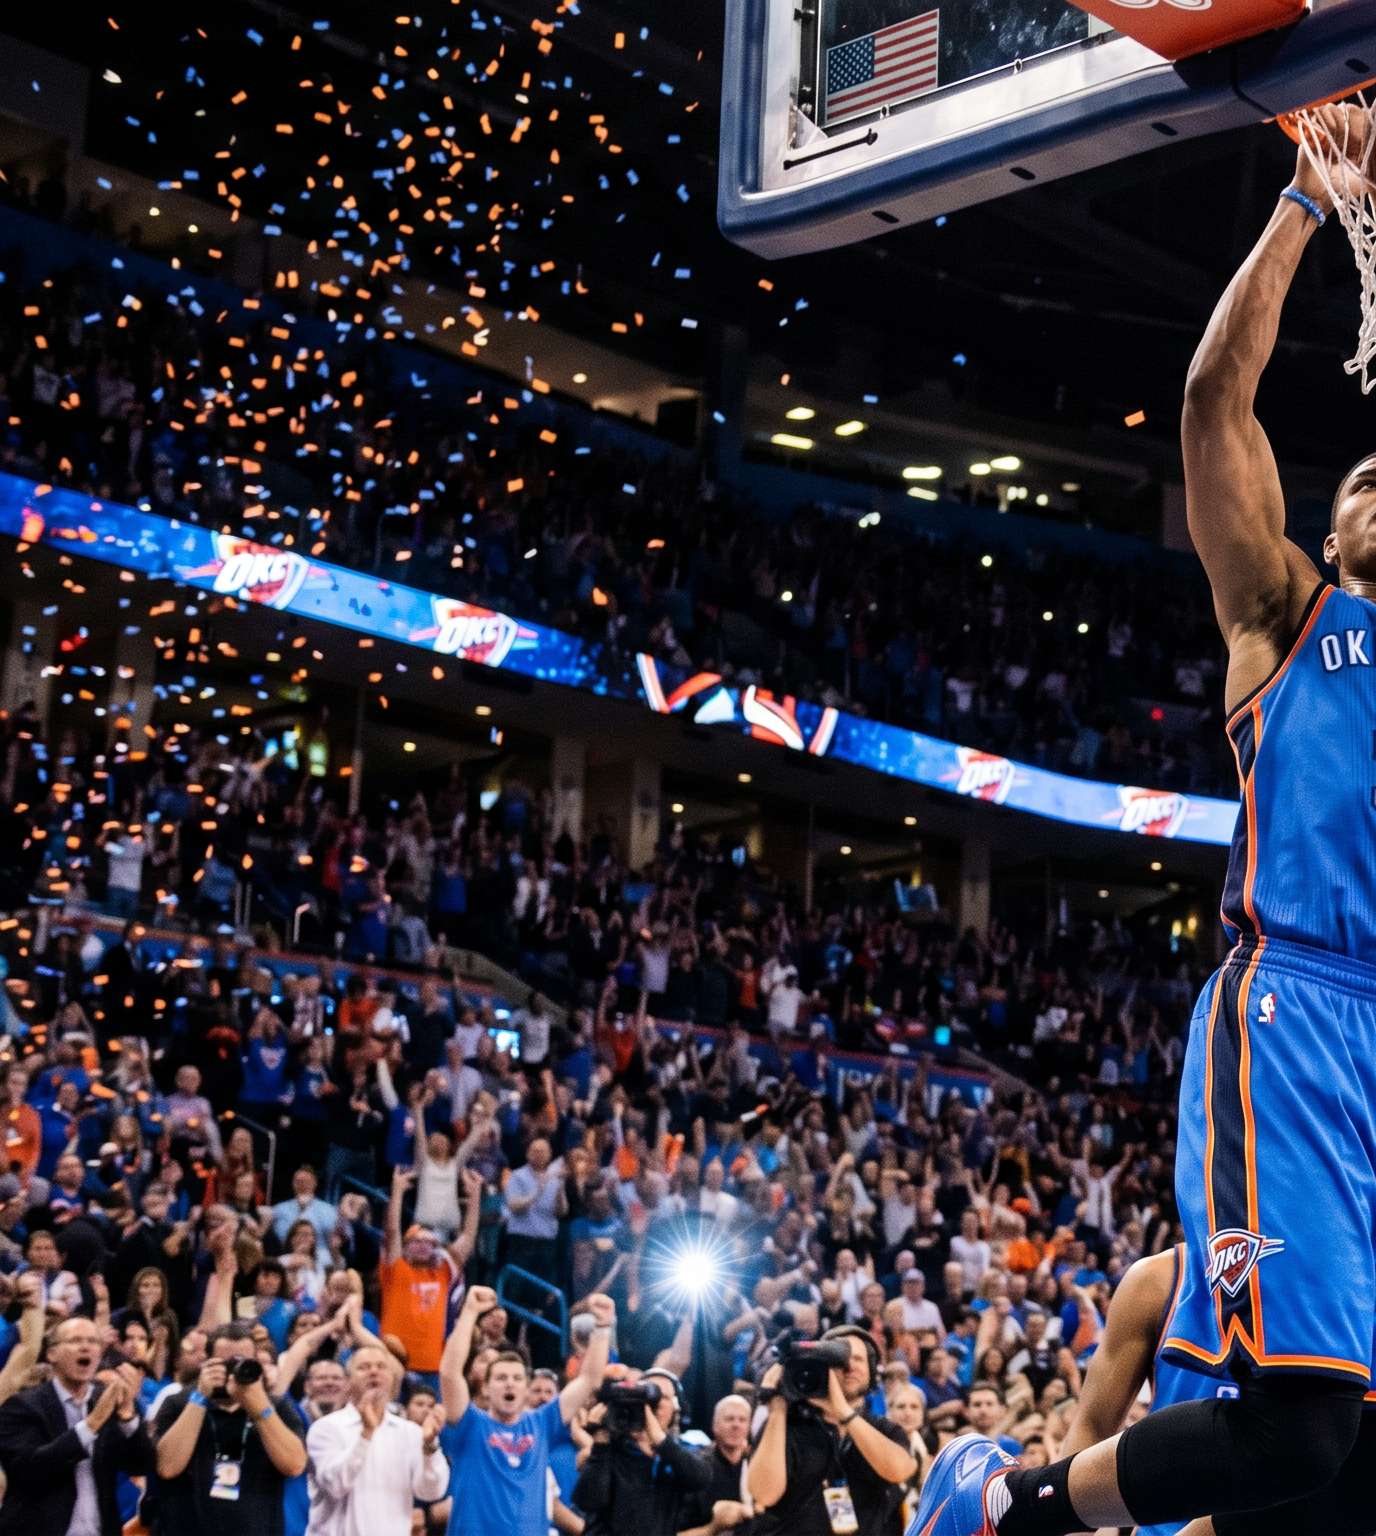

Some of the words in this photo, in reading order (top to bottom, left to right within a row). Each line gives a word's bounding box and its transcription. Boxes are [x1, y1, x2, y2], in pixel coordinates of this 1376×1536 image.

[213, 553, 289, 592] OKC
[433, 616, 500, 653] OKC
[1211, 1240, 1248, 1284] OKC
